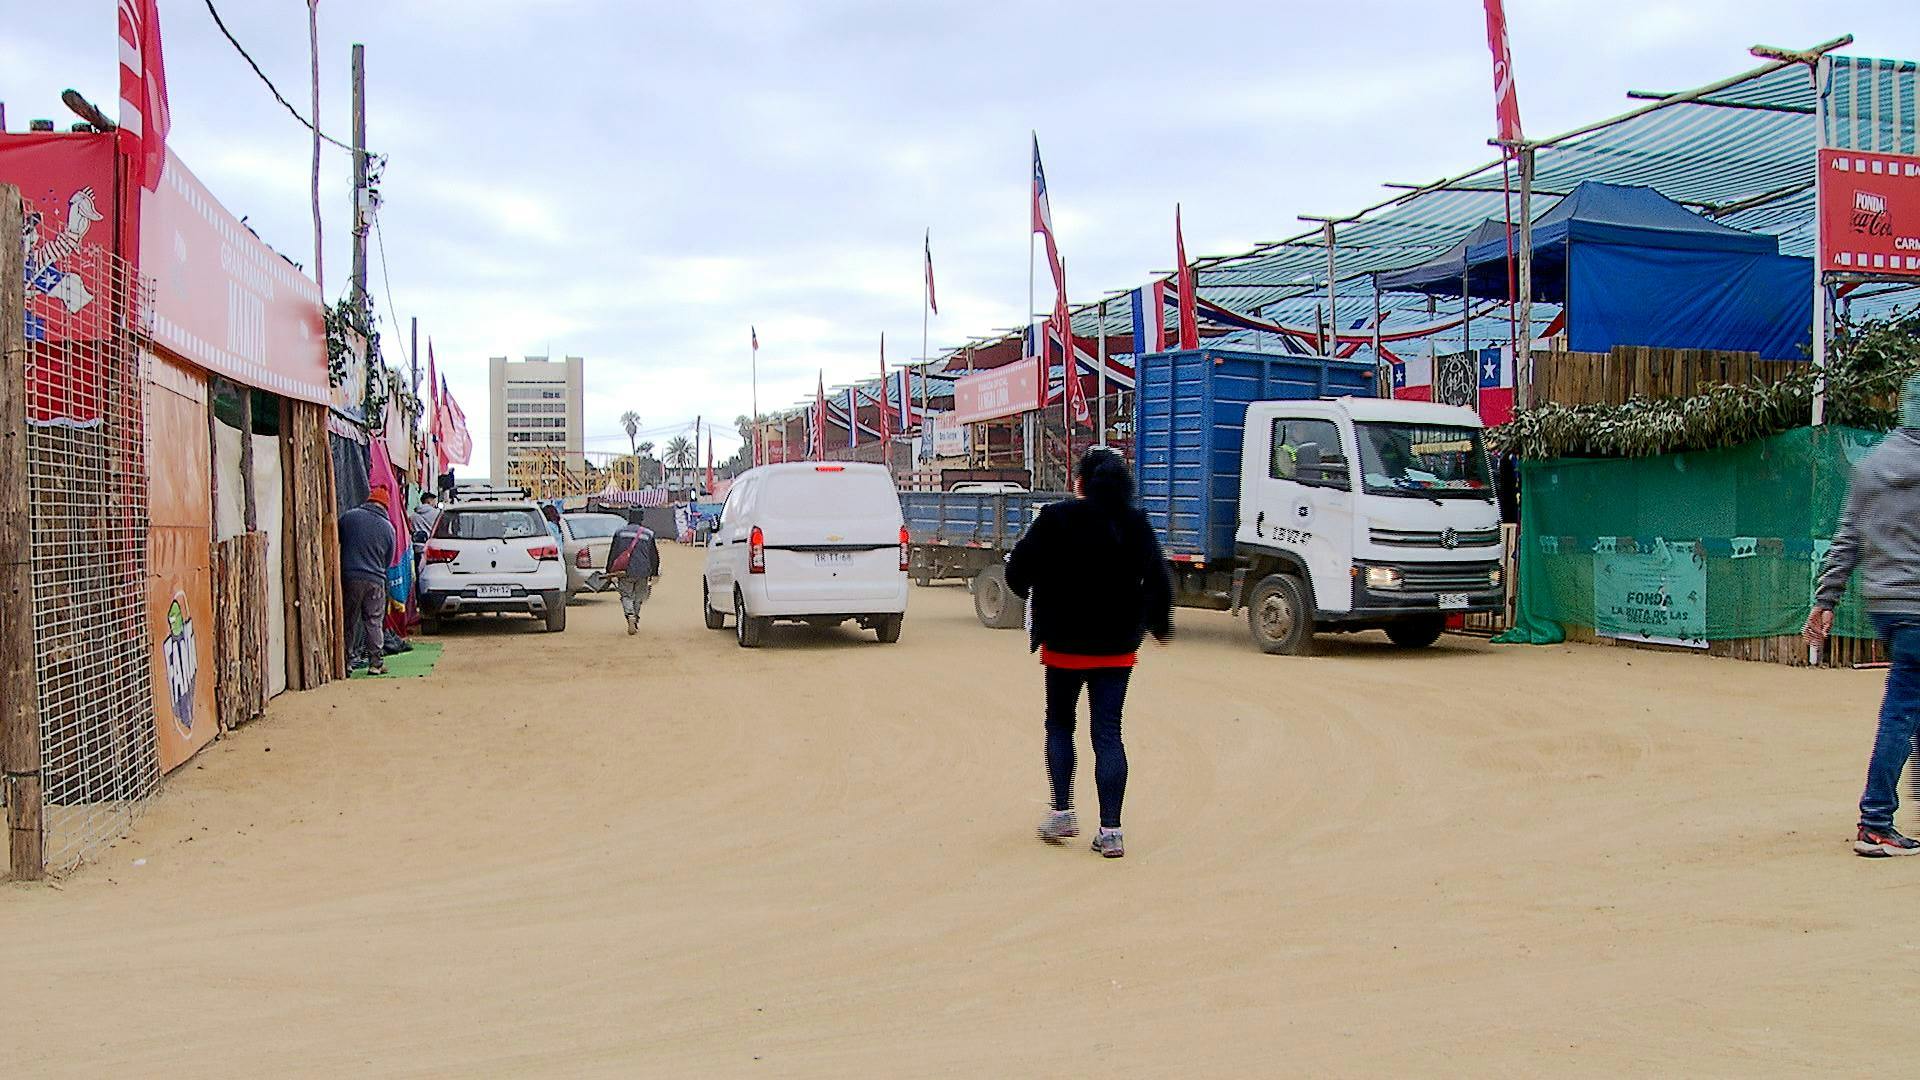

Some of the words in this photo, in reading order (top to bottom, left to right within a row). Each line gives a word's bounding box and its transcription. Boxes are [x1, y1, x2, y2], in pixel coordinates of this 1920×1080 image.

[1855, 191, 1884, 214] FONDA
[1626, 592, 1674, 606] FONDA
[1611, 606, 1623, 615] LA
[1625, 607, 1650, 618] RUTA
[1669, 611, 1689, 621] LAS
